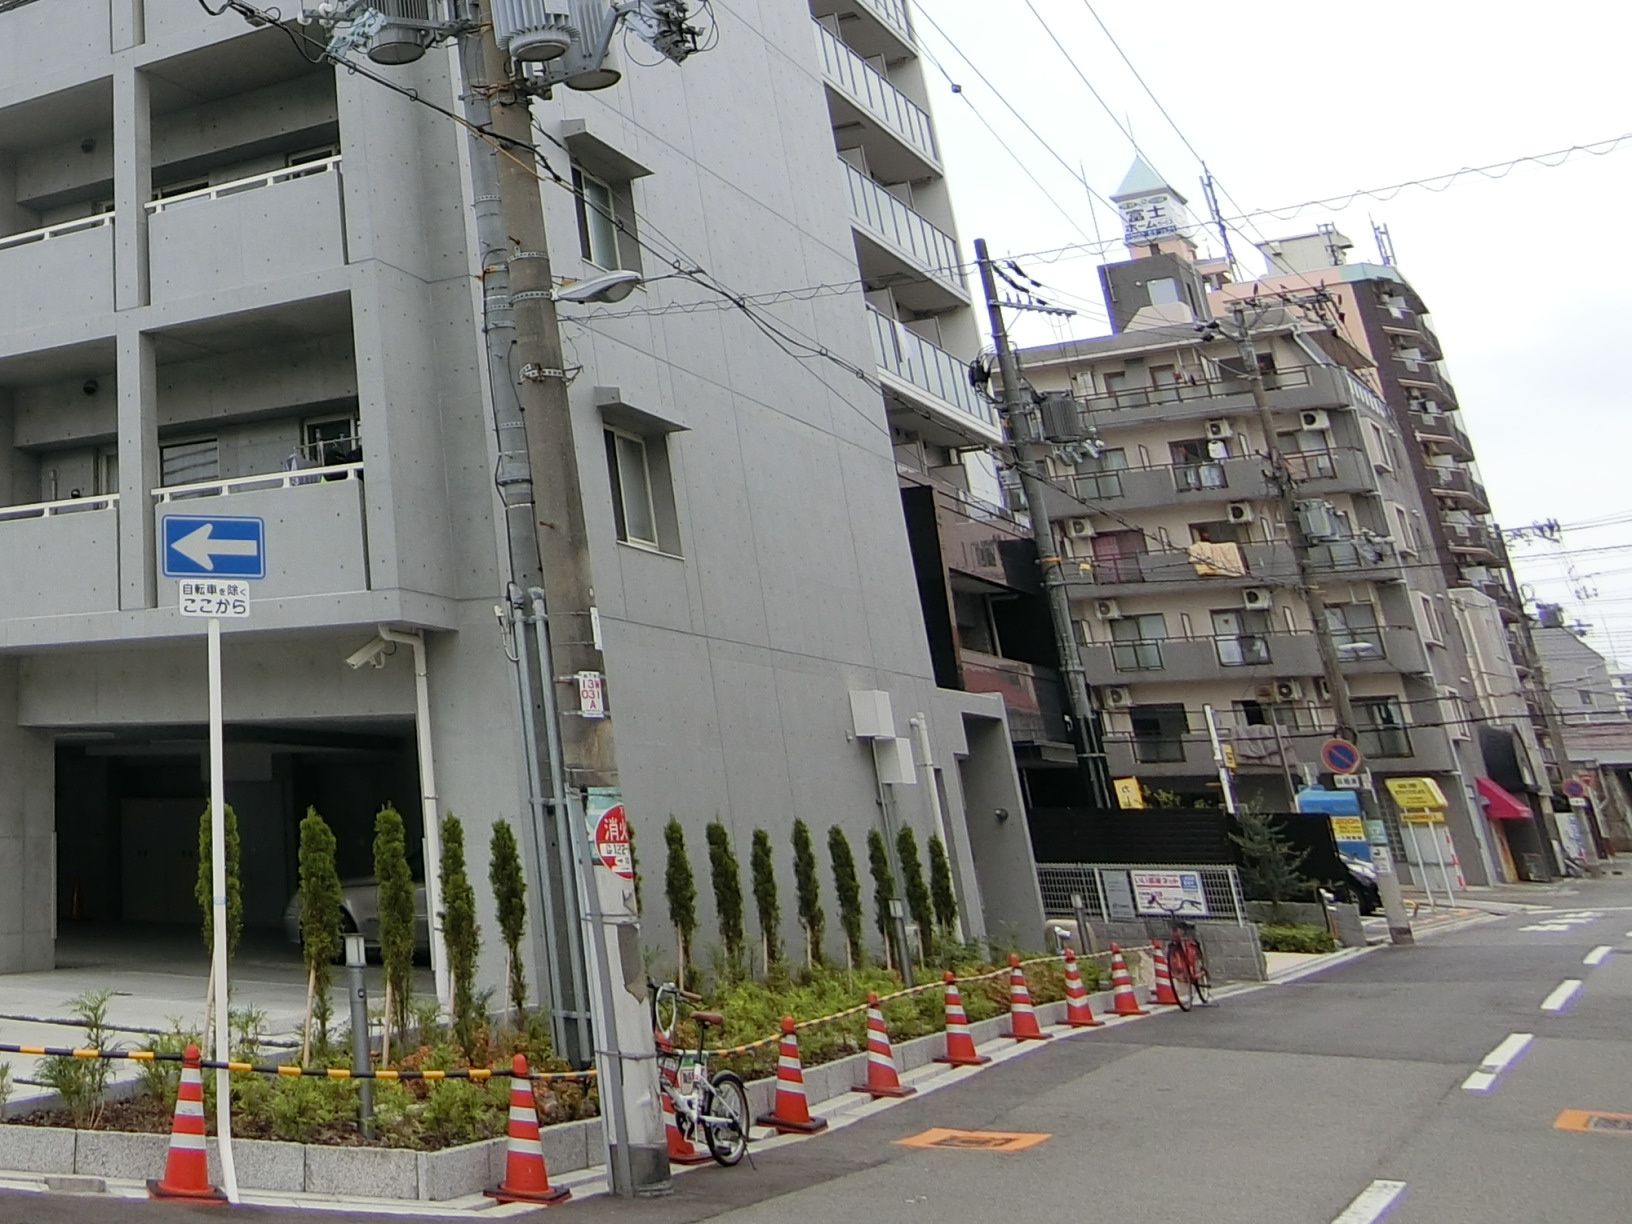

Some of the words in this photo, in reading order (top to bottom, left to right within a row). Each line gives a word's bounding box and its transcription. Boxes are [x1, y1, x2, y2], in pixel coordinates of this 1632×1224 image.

[1126, 206, 1166, 222] 富士
[183, 583, 246, 596] 自転車を除く
[184, 598, 246, 614] ここから
[581, 689, 600, 699] 031
[589, 699, 597, 710] A
